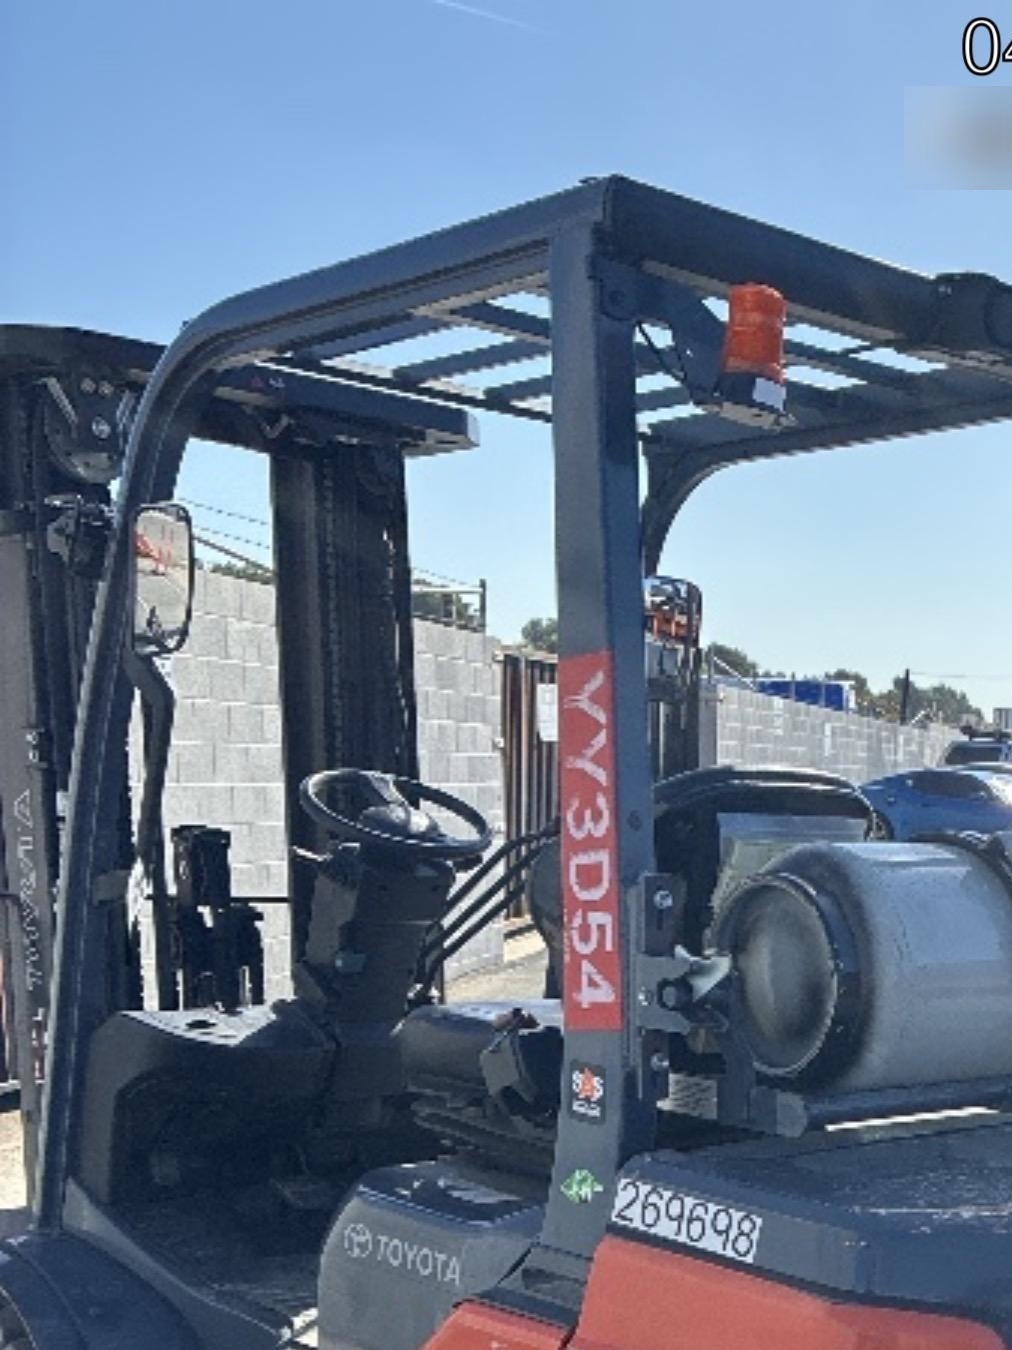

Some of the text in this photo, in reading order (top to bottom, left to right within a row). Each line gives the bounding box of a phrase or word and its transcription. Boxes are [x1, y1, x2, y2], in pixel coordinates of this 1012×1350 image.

[564, 670, 616, 1008] YY3D54
[615, 1180, 757, 1258] 269698
[375, 1235, 460, 1287] TOYOTA
